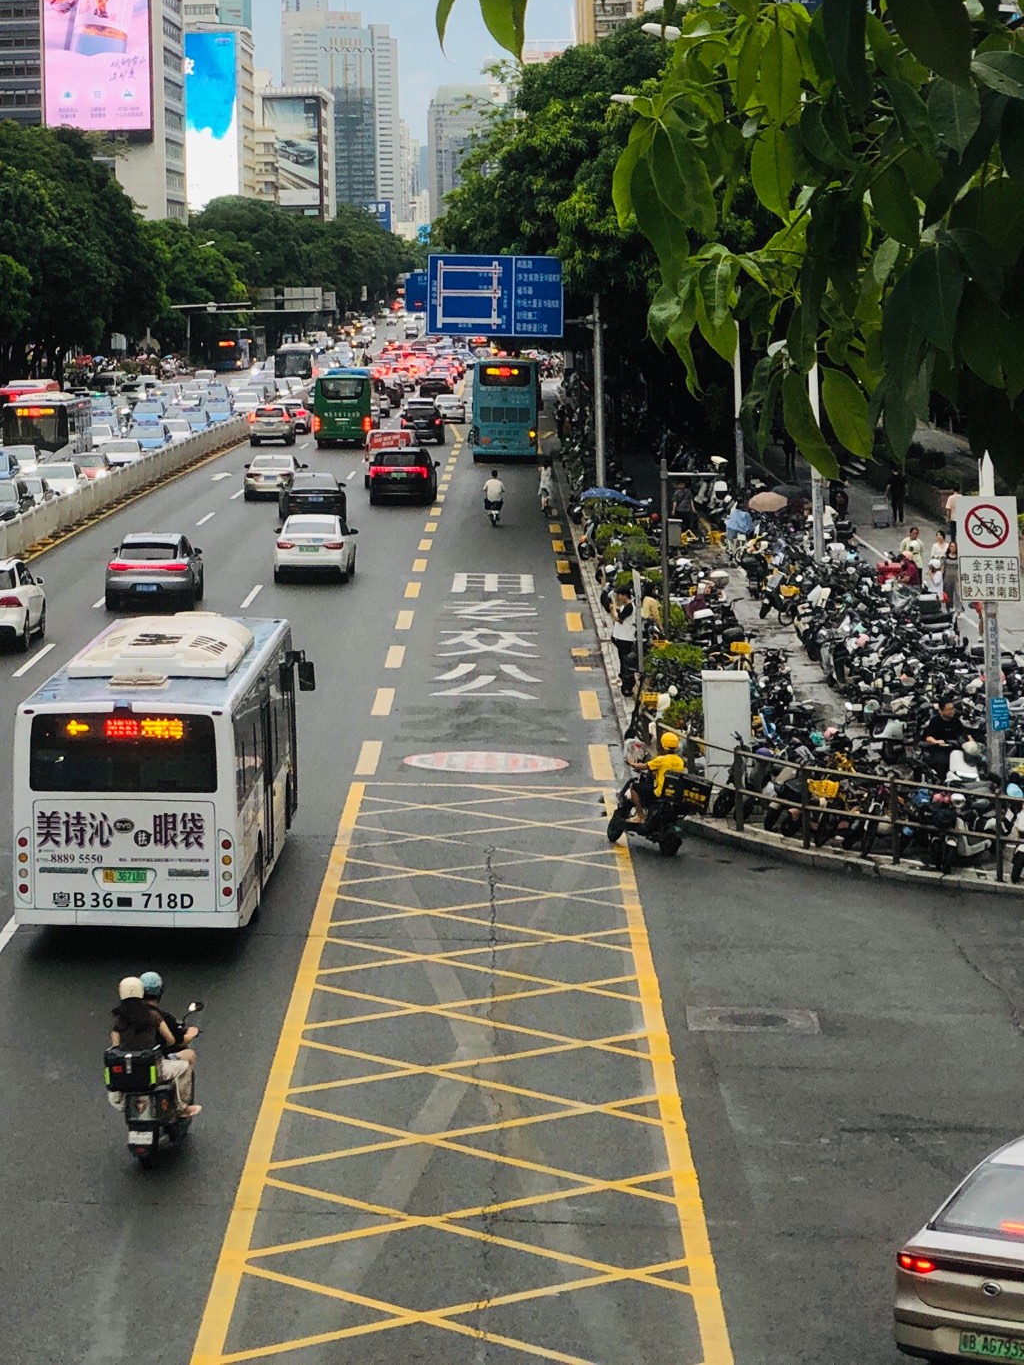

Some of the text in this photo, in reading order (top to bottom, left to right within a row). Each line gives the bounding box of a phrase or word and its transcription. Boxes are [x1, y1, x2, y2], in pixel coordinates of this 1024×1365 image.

[972, 559, 1017, 572] 全天禁止
[960, 572, 1019, 585] 电动自行车
[963, 586, 1018, 598] 驶入深南路
[36, 810, 114, 849] 美诗沁
[153, 812, 205, 850] 眼袋
[78, 854, 103, 864] 5550
